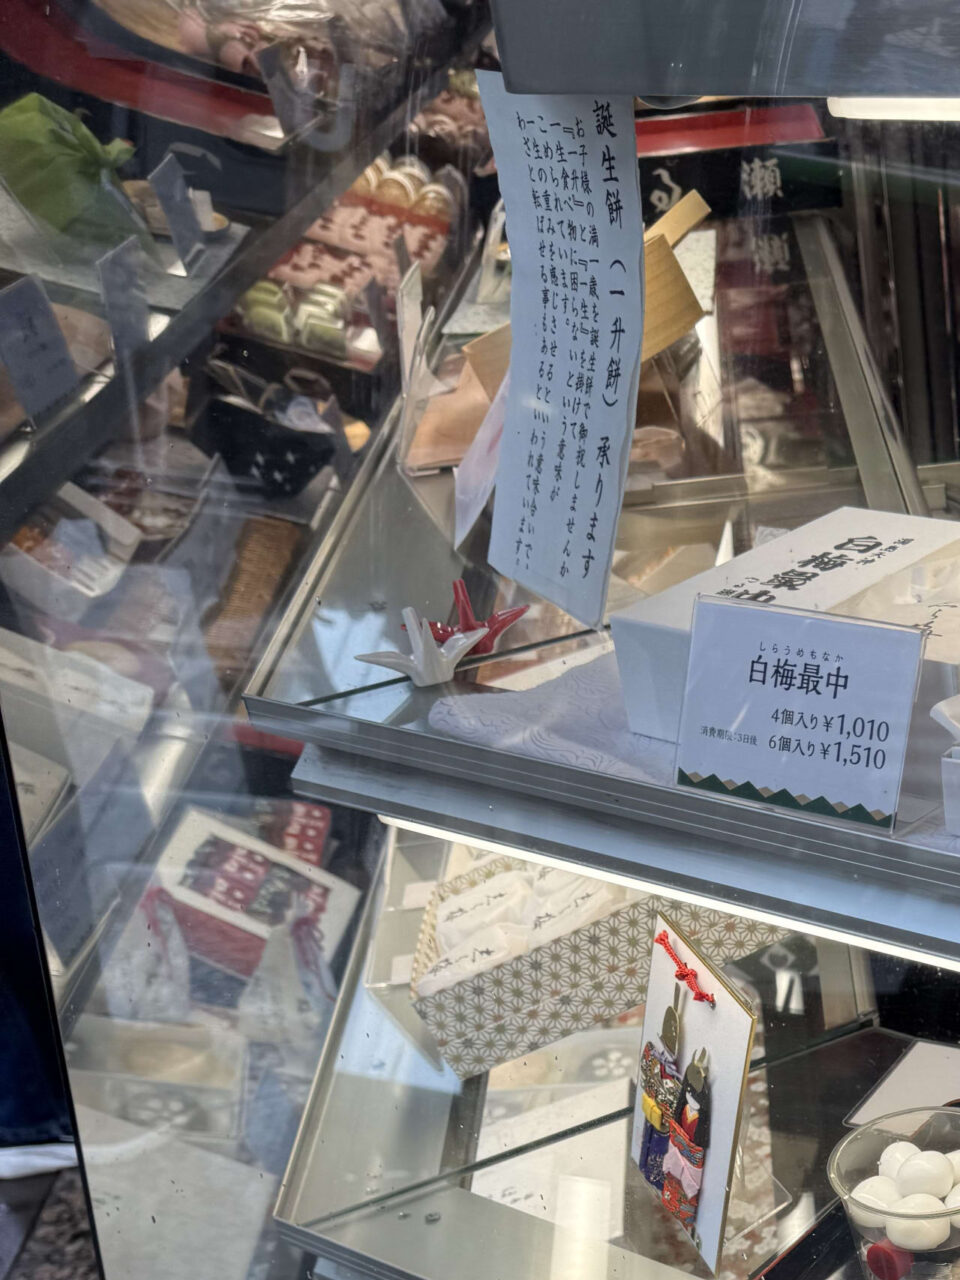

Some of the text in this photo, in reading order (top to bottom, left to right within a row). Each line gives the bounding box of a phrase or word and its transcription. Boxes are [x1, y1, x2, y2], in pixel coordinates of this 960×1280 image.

[740, 157, 783, 201] 瀬
[734, 535, 883, 604] 白梅最中
[758, 640, 845, 663] しらうめもなか
[747, 655, 850, 700] 白梅最中
